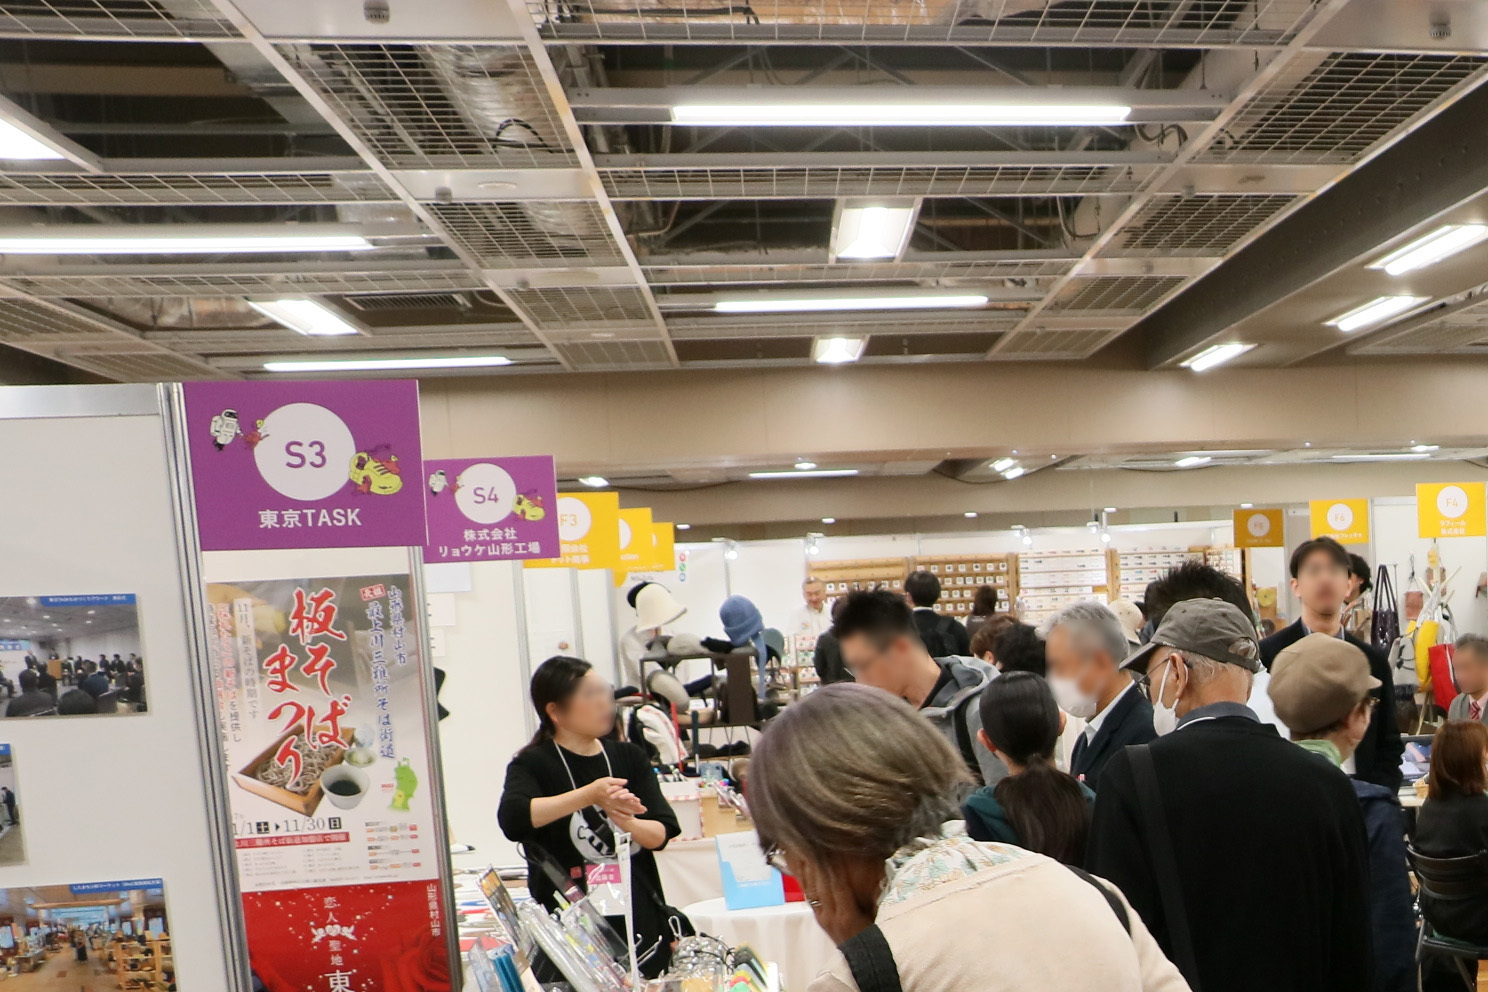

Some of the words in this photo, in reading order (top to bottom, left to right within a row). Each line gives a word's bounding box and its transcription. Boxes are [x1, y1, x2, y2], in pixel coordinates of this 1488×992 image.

[285, 441, 327, 469] S3
[473, 488, 499, 504] S4
[1446, 498, 1459, 508] F4
[258, 508, 362, 530] 東京TASK
[560, 514, 577, 527] F3
[463, 528, 517, 542] 株式会社
[438, 542, 541, 558] リョウケ山形工場
[290, 587, 353, 751] 板そば
[263, 643, 306, 791] まつり
